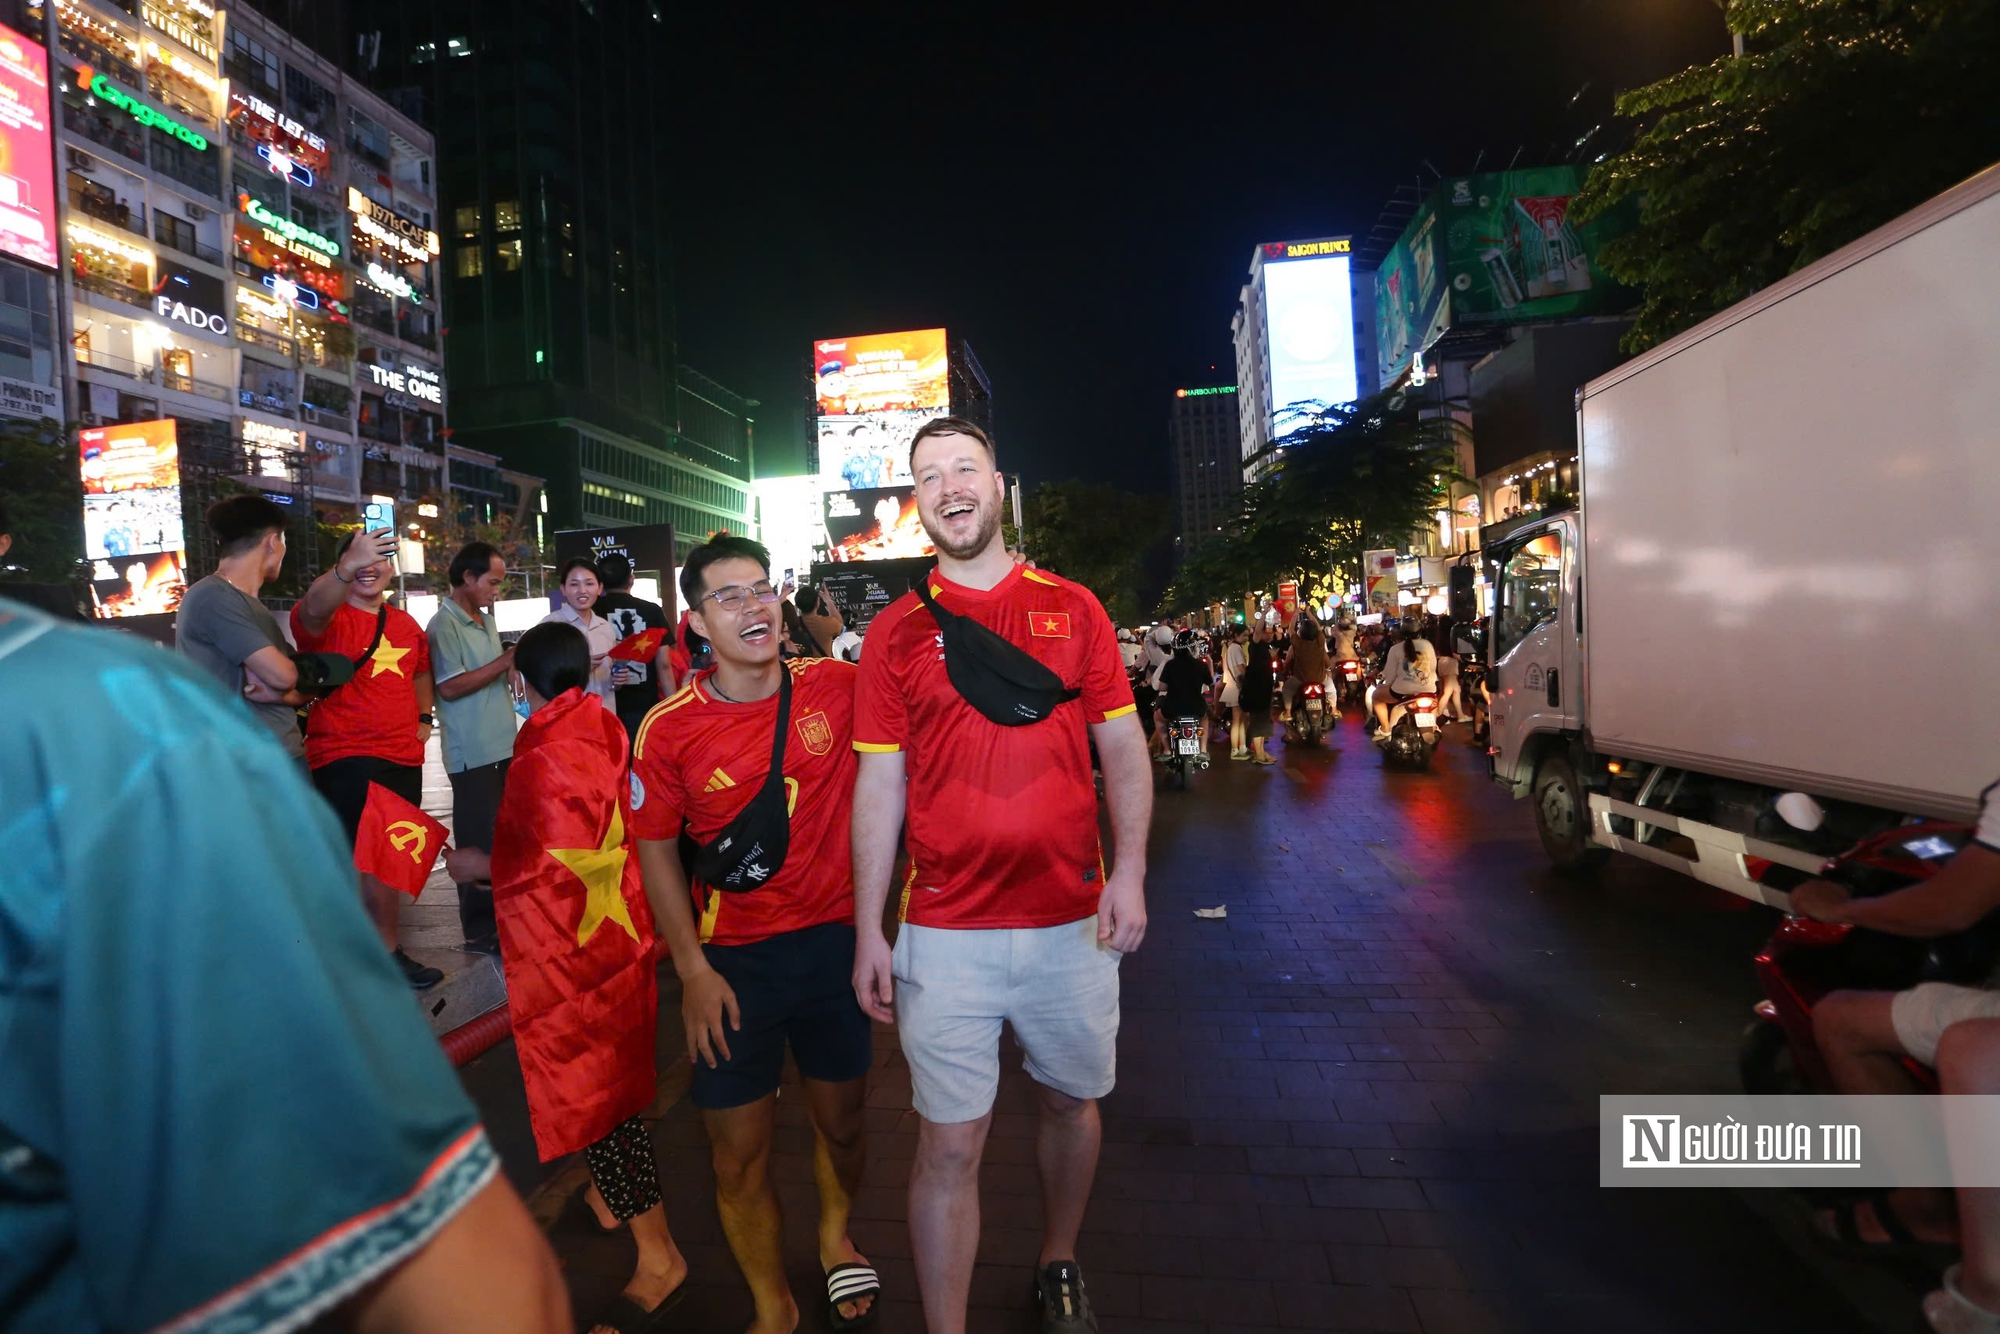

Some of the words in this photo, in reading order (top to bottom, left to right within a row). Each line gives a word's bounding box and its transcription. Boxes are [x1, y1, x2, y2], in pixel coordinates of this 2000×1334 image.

[248, 94, 276, 123] THE
[277, 113, 326, 153] LETER
[262, 227, 288, 249] THE
[288, 240, 331, 269] LETTER
[1287, 243, 1319, 257] SAIGON
[1319, 240, 1350, 254] PRINCE
[157, 295, 228, 335] FADO
[369, 364, 405, 392] THE
[408, 378, 442, 404] ONE
[1185, 387, 1218, 397] HARBOUR
[1218, 386, 1236, 394] VIEW
